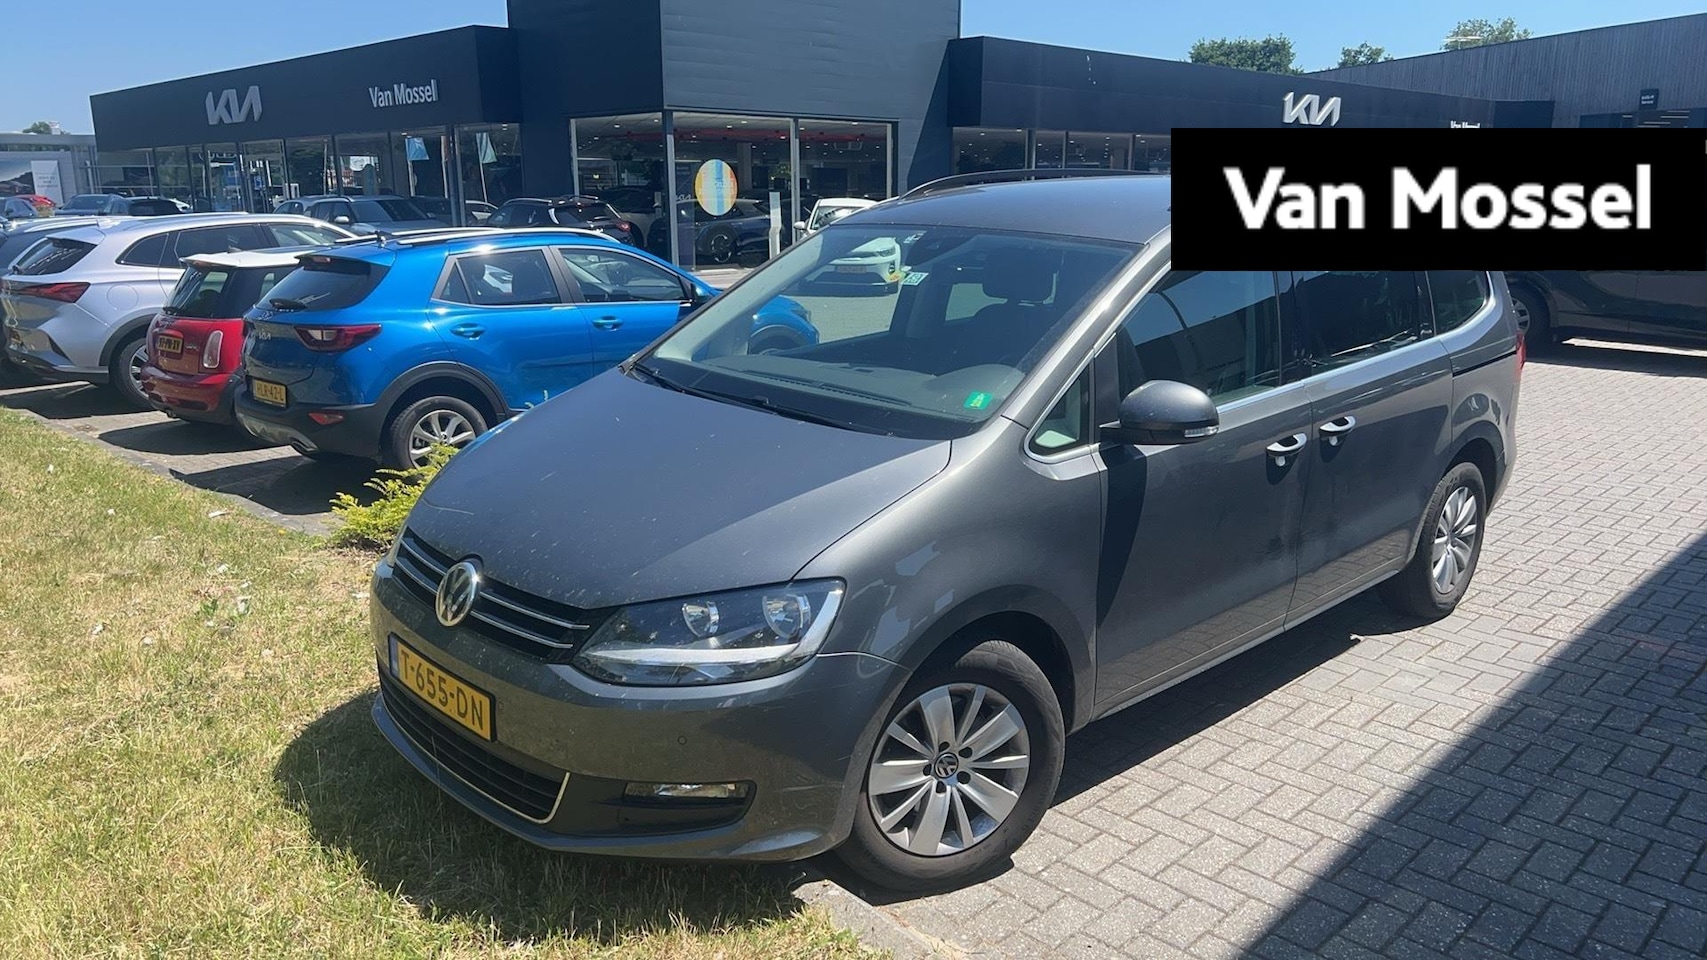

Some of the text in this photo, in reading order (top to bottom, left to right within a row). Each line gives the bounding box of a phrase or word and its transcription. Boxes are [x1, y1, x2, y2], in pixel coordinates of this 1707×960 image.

[206, 85, 262, 125] KIA
[369, 79, 438, 108] Van Mossel
[1283, 91, 1342, 127] KIA
[401, 649, 484, 731] T-655-DN
